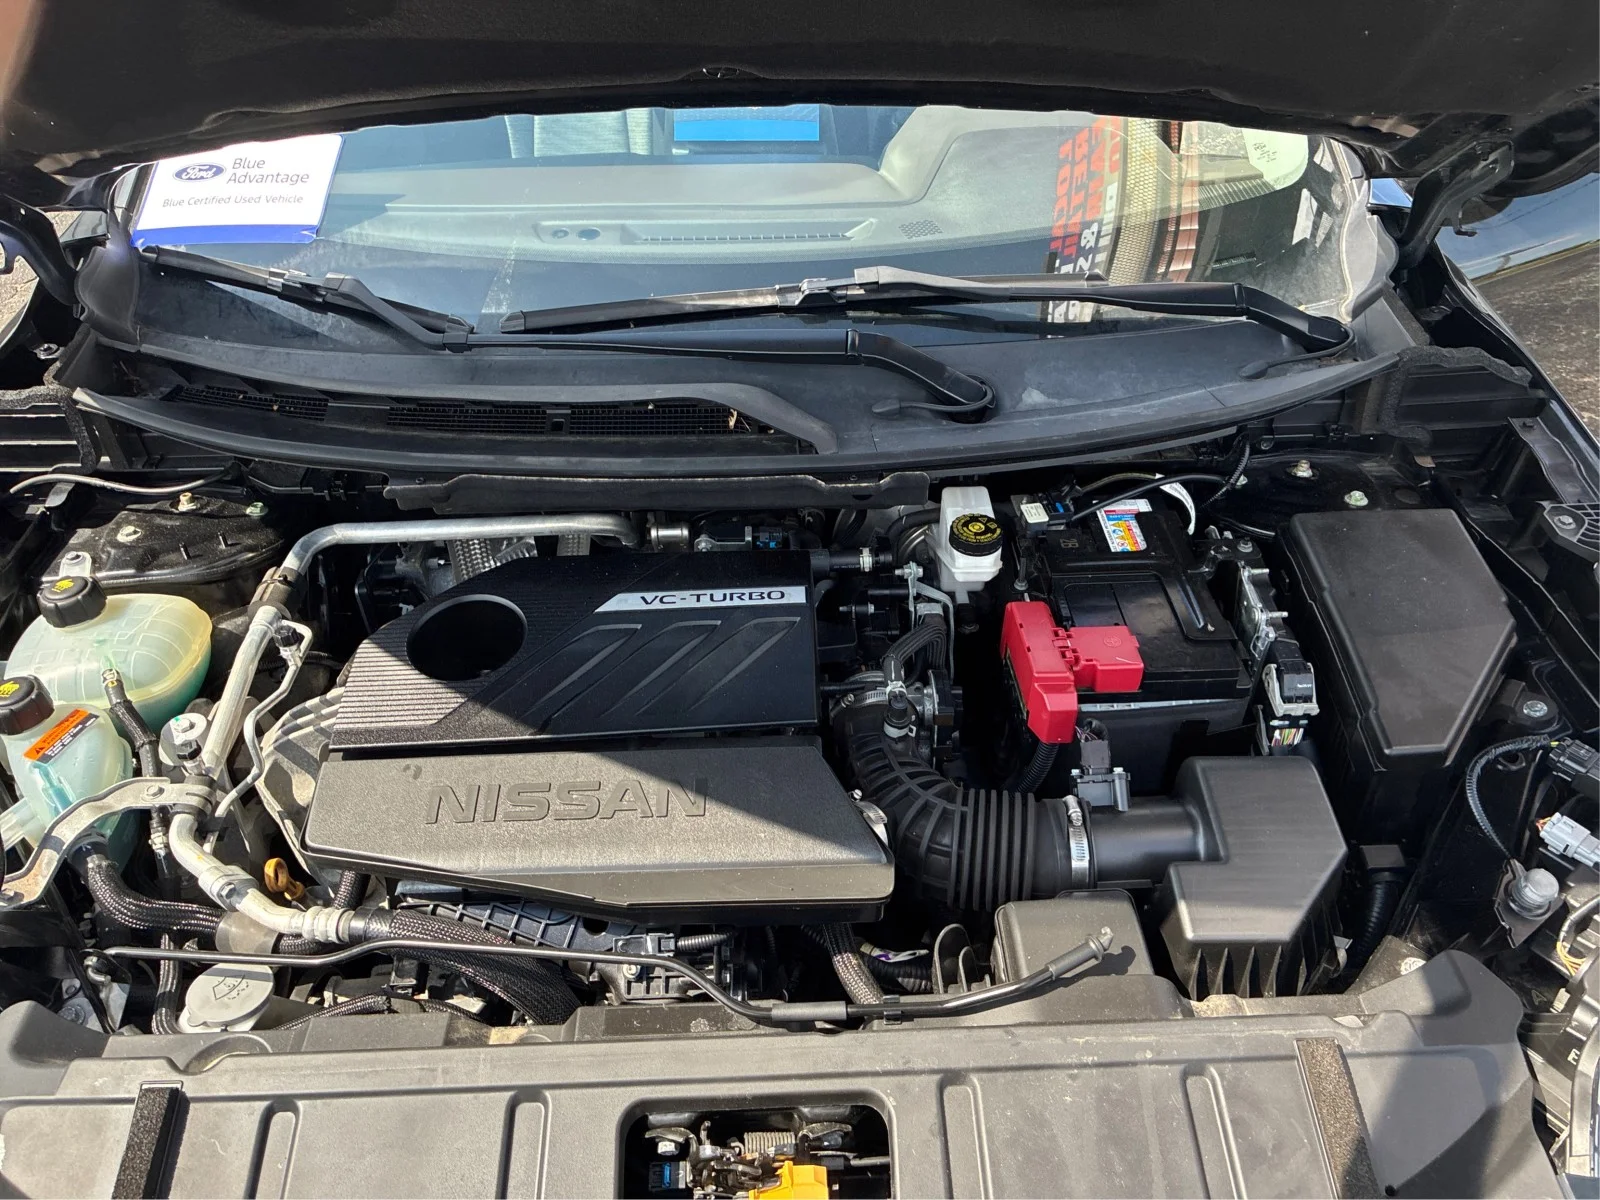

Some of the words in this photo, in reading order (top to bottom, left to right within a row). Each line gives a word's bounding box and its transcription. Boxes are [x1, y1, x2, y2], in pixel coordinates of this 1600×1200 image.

[232, 157, 266, 170] Blue
[181, 164, 217, 181] Ford
[226, 172, 310, 186] Advantage
[162, 198, 185, 208] Blue
[187, 195, 231, 206] Certified
[234, 194, 261, 204] Used
[265, 194, 304, 204] Vehicle
[639, 589, 786, 606] VC-TURBO
[424, 777, 708, 825] NISSAN
